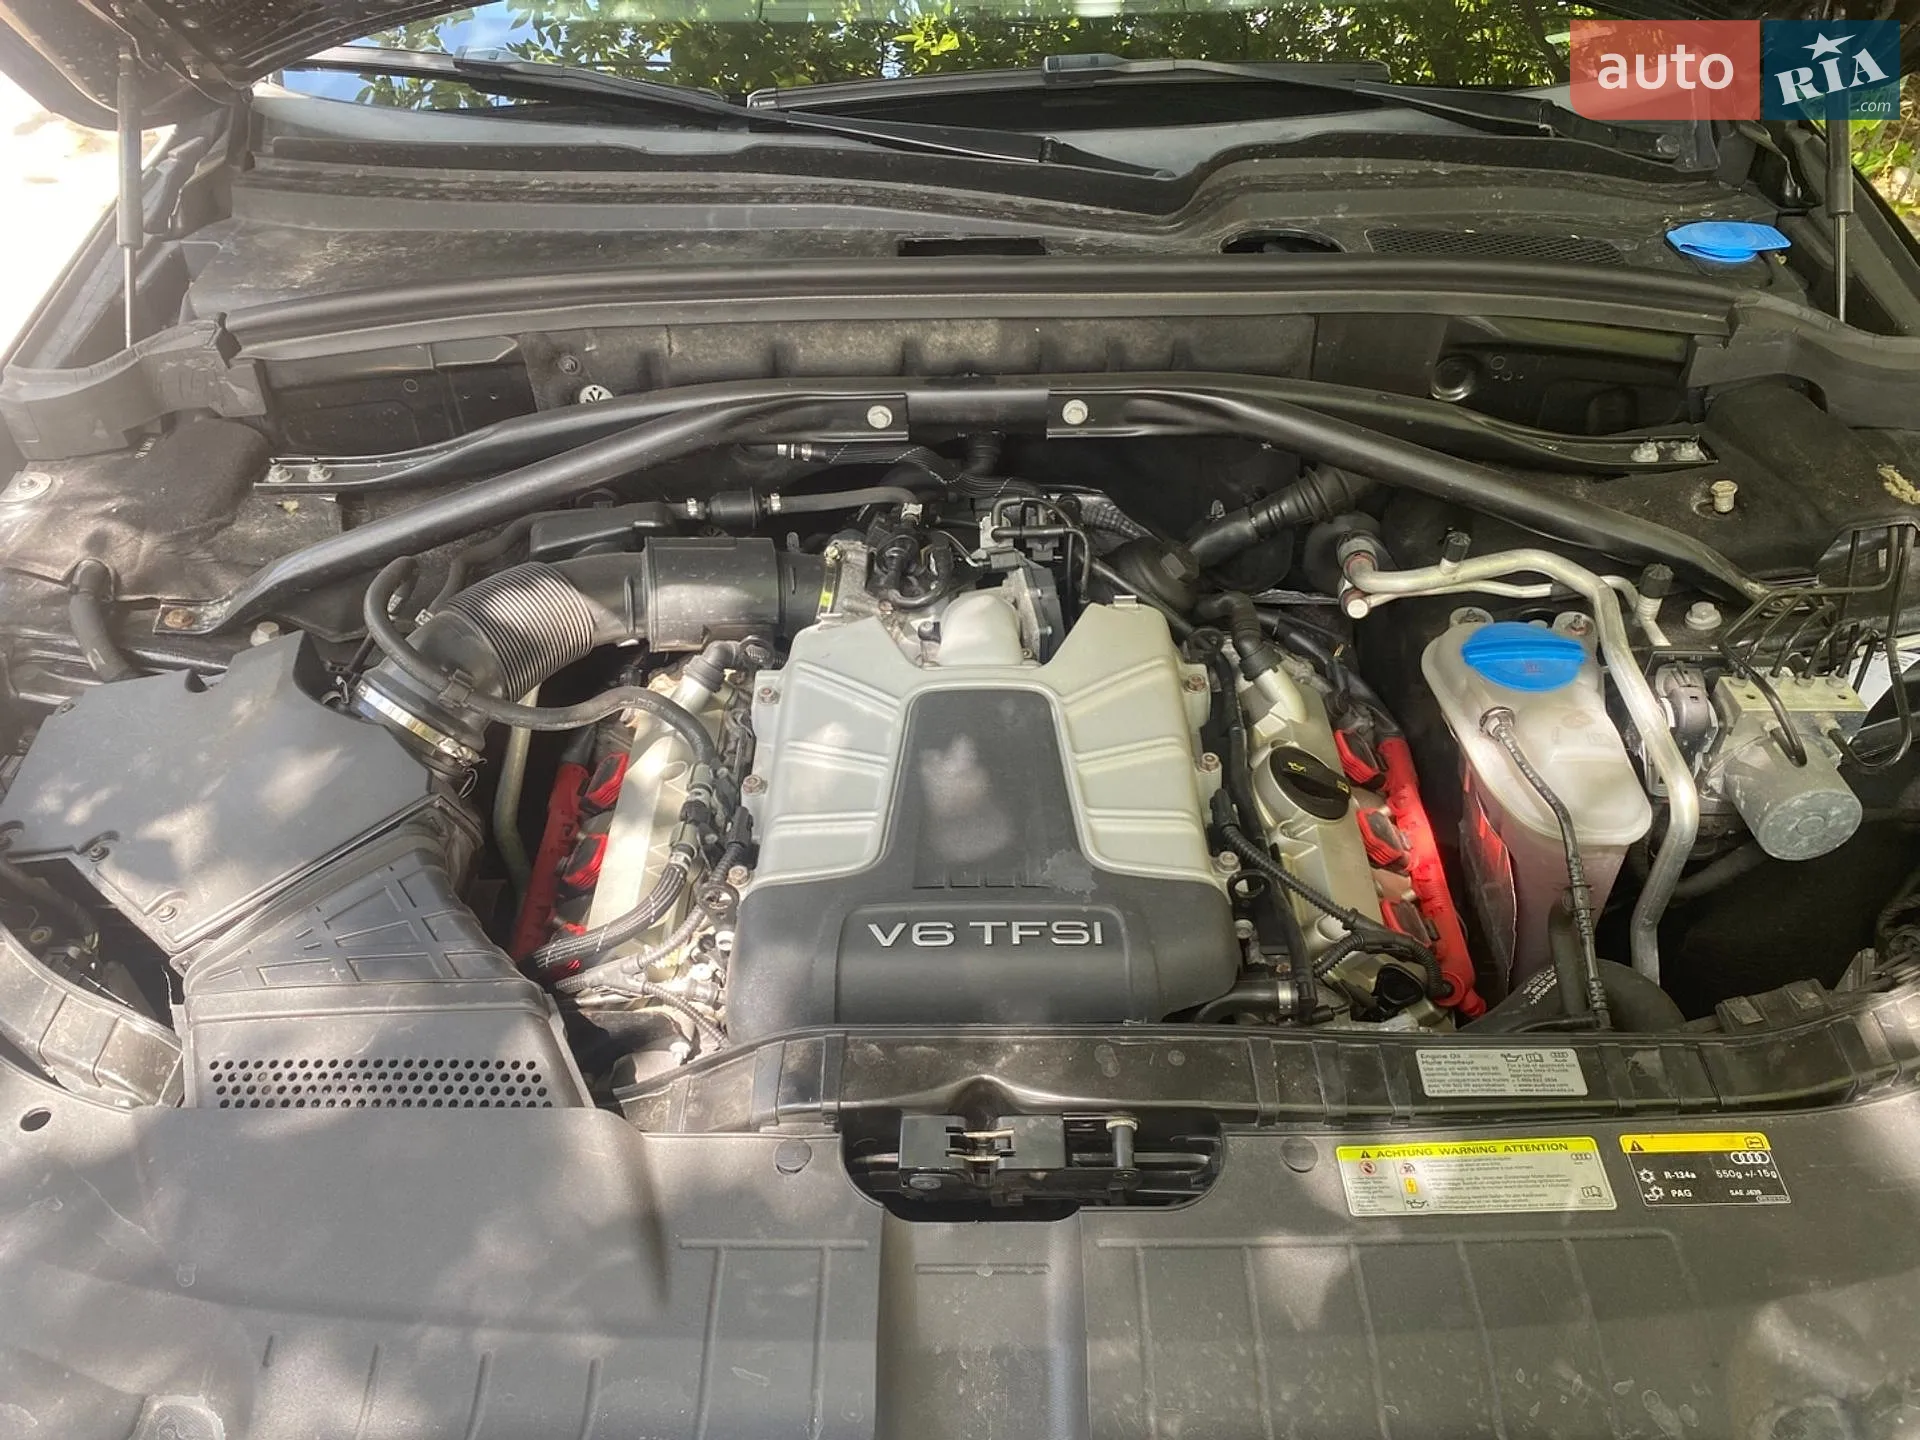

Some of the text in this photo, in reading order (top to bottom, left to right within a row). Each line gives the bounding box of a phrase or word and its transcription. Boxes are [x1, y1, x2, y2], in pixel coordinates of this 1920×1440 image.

[867, 921, 1103, 947] V6 TFSI
[1376, 1142, 1569, 1158] ACHTUNG WARNING ATTENTION
[1664, 1170, 1697, 1179] R-134a
[1716, 1169, 1743, 1180] 550g
[1670, 1188, 1693, 1198] PAG
